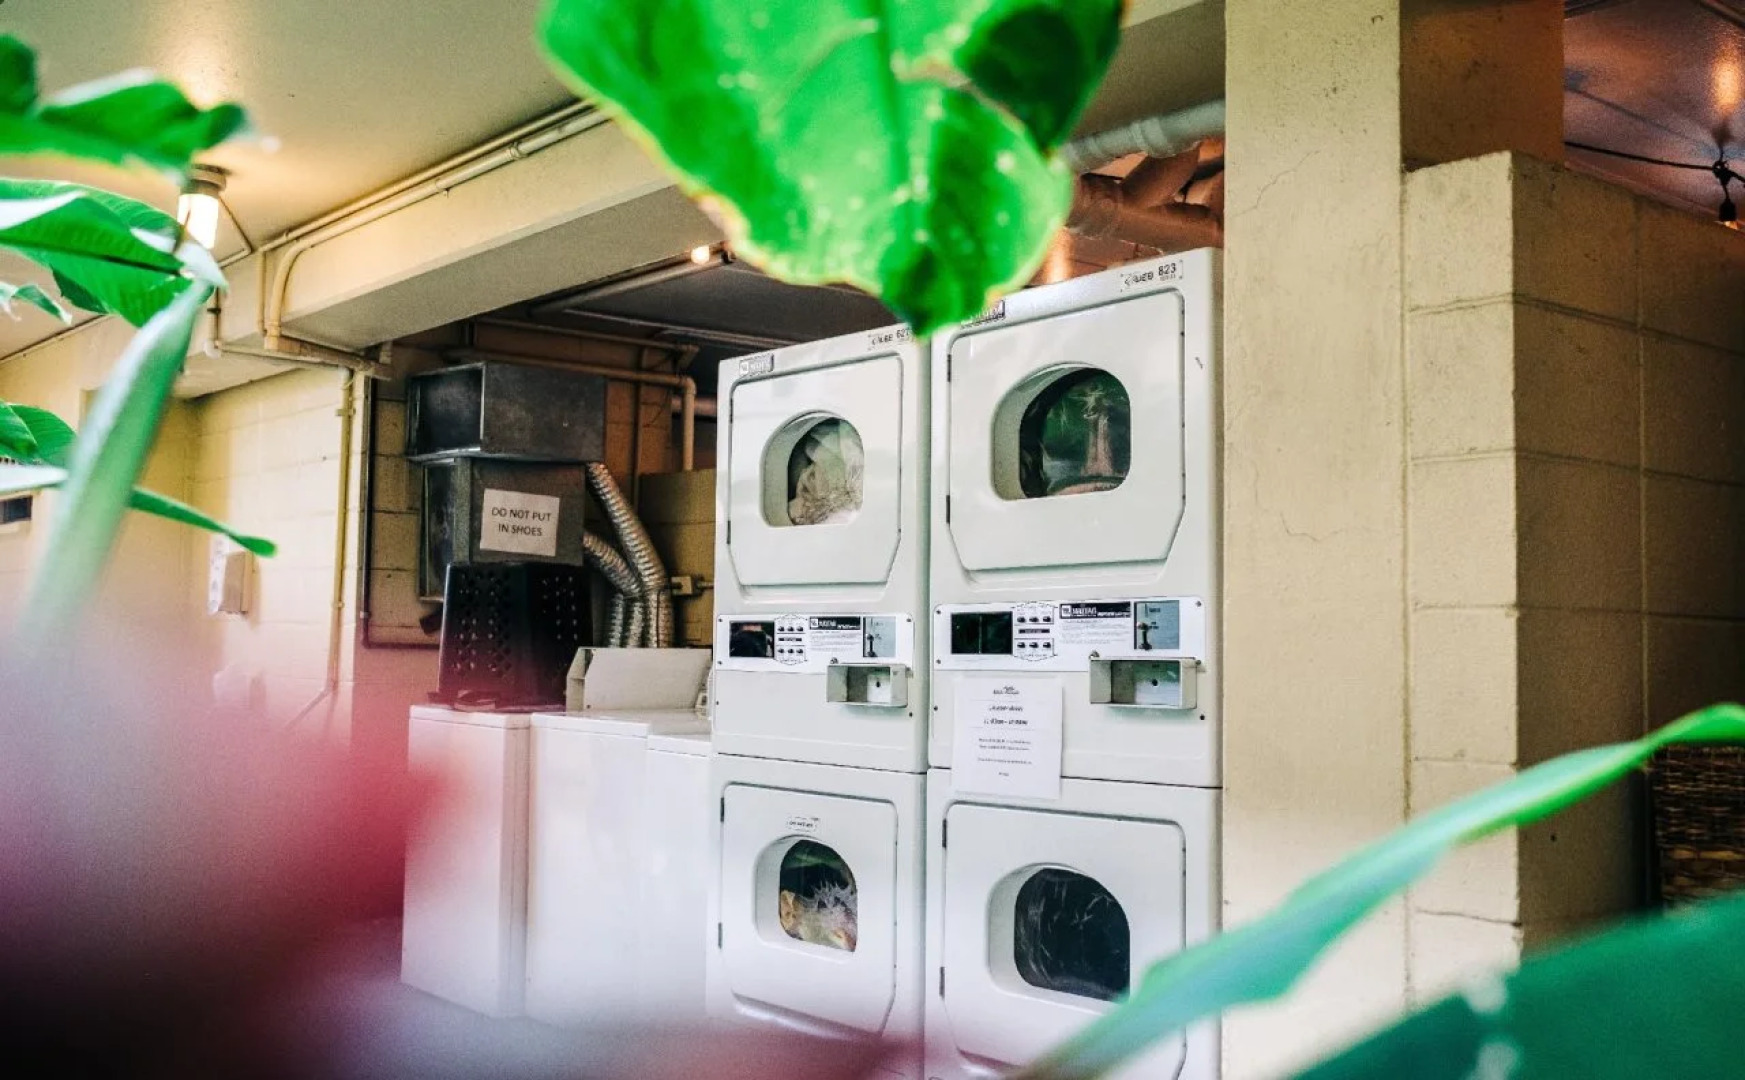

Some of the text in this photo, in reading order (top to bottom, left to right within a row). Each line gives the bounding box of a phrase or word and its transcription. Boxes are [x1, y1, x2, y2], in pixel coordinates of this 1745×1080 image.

[1158, 262, 1176, 276] 823
[491, 507, 552, 522] DO NOT PUT
[498, 523, 543, 536] IN SHOES
